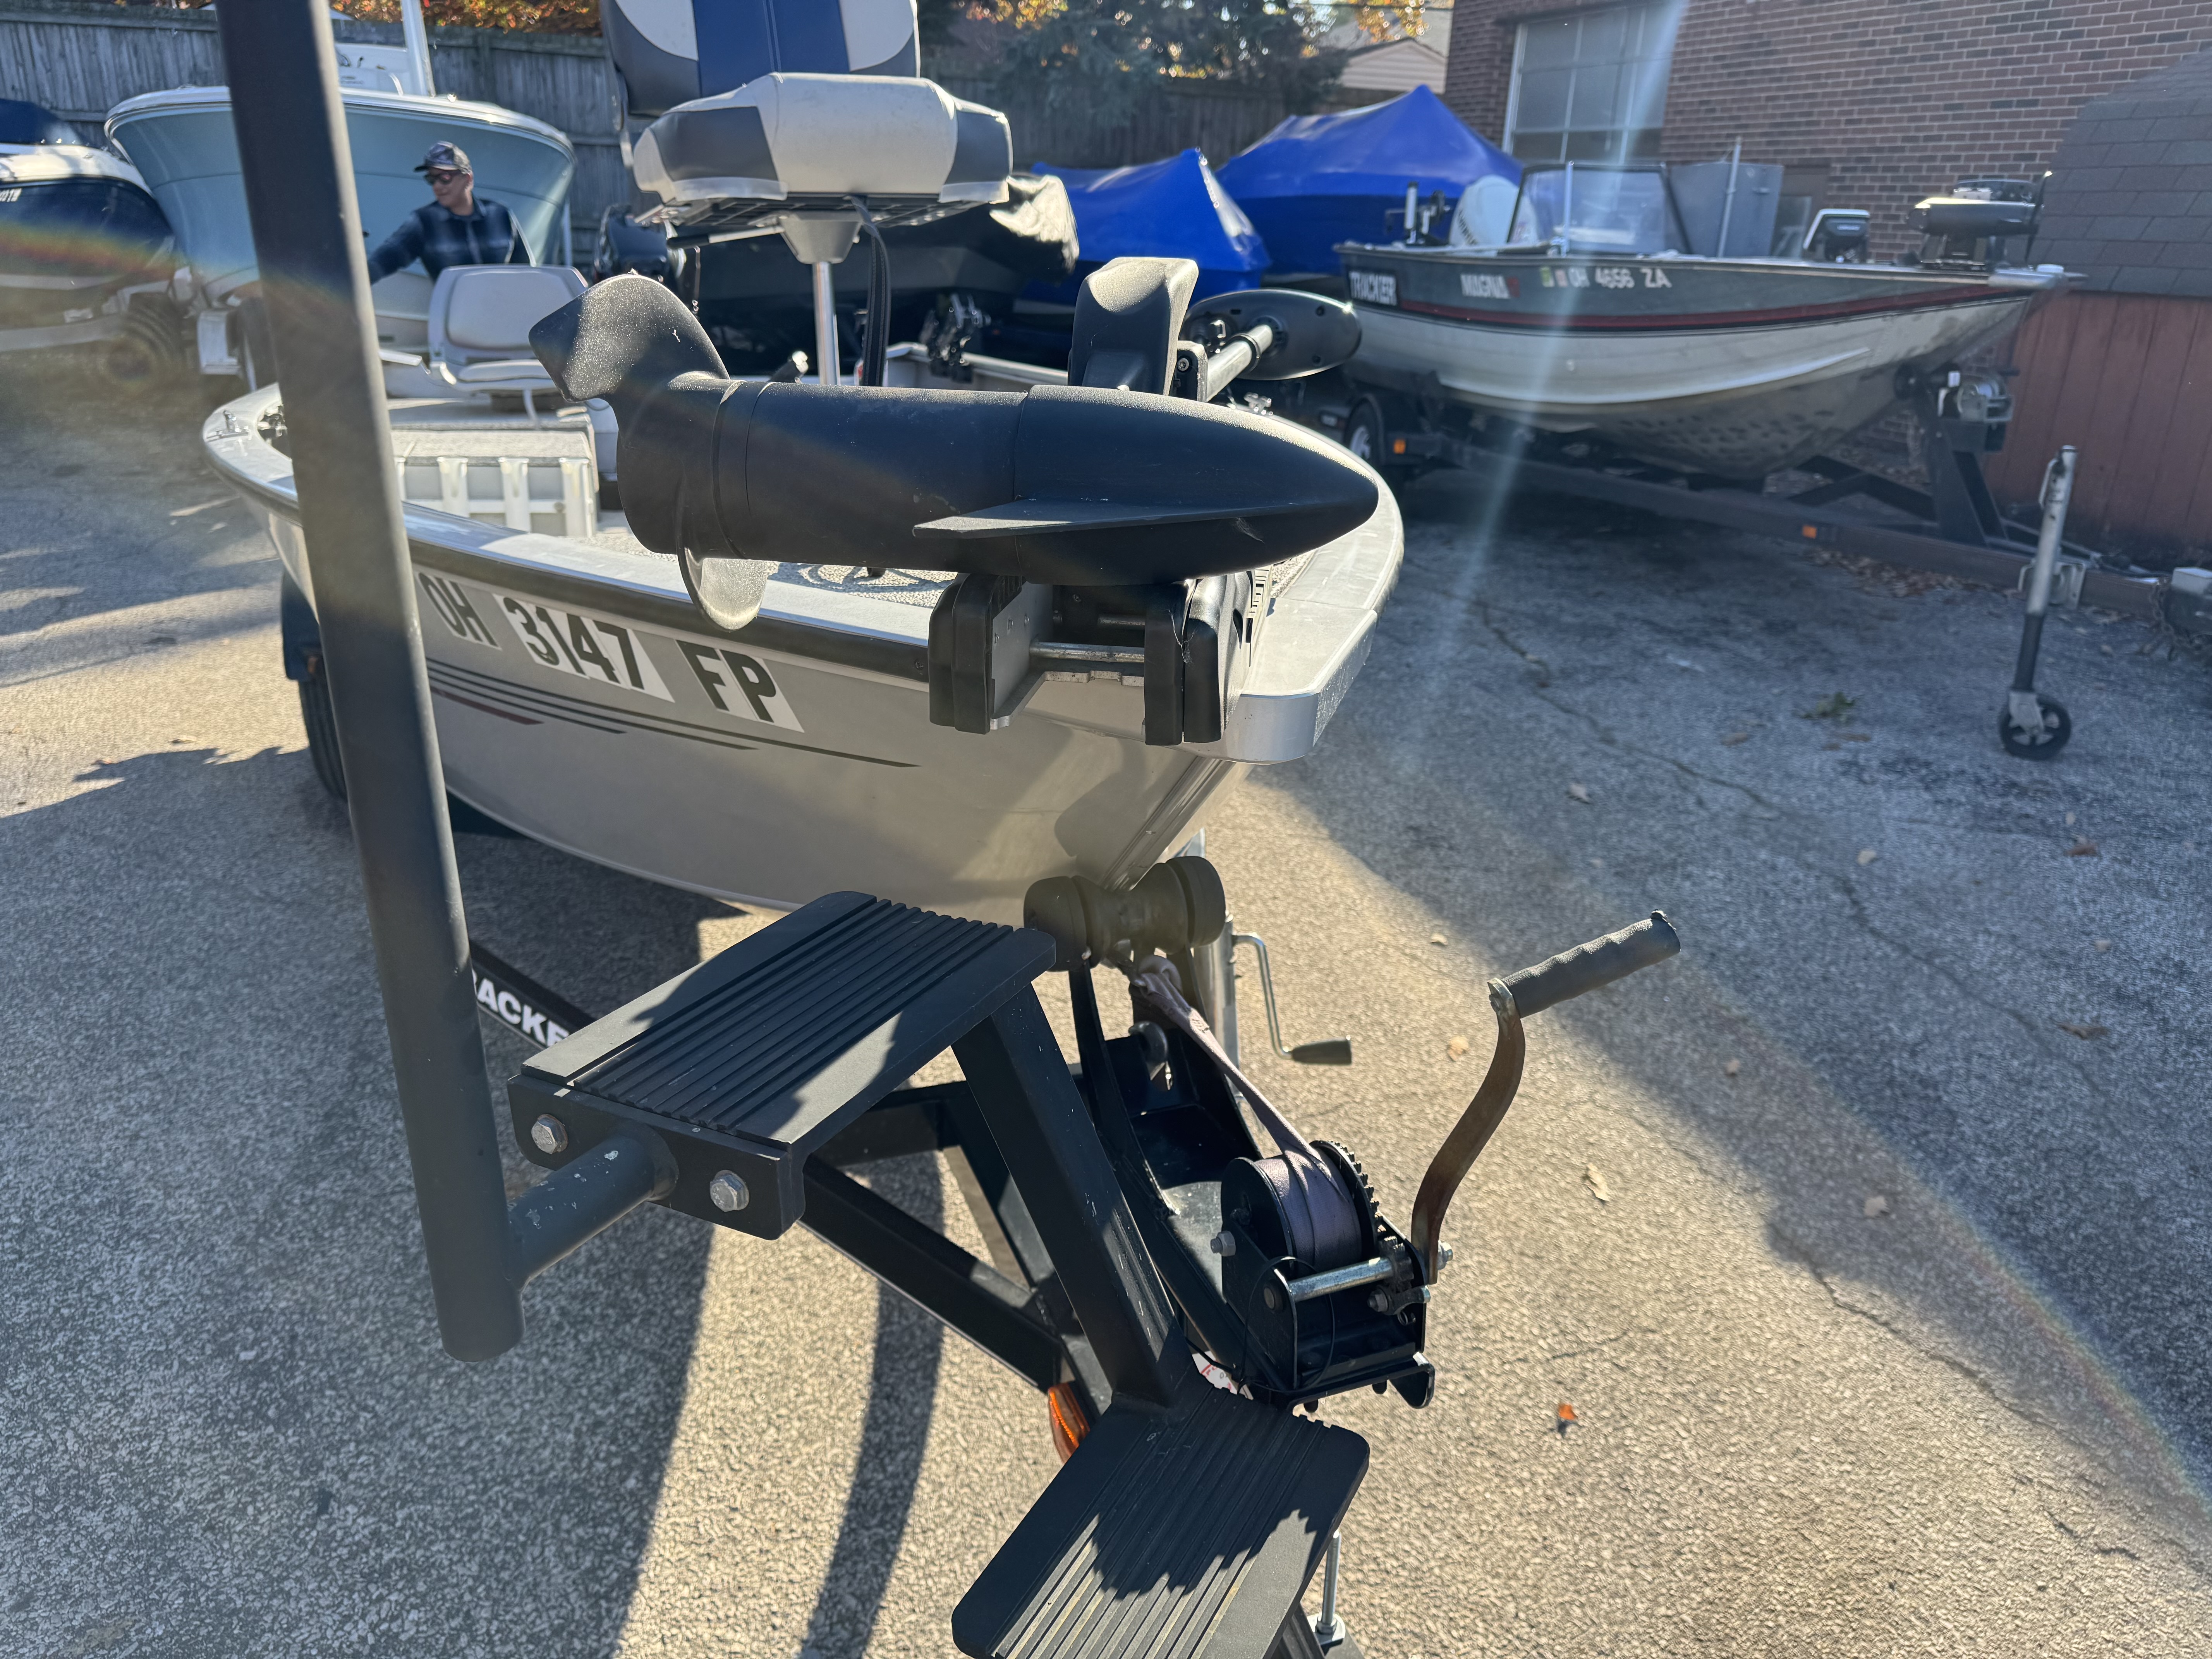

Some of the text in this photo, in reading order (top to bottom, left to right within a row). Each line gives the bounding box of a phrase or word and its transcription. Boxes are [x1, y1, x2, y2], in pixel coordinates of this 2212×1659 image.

[1640, 267, 1672, 288] ZA
[418, 571, 777, 723] OH 3147 FP
[472, 969, 569, 1046] ACKE
